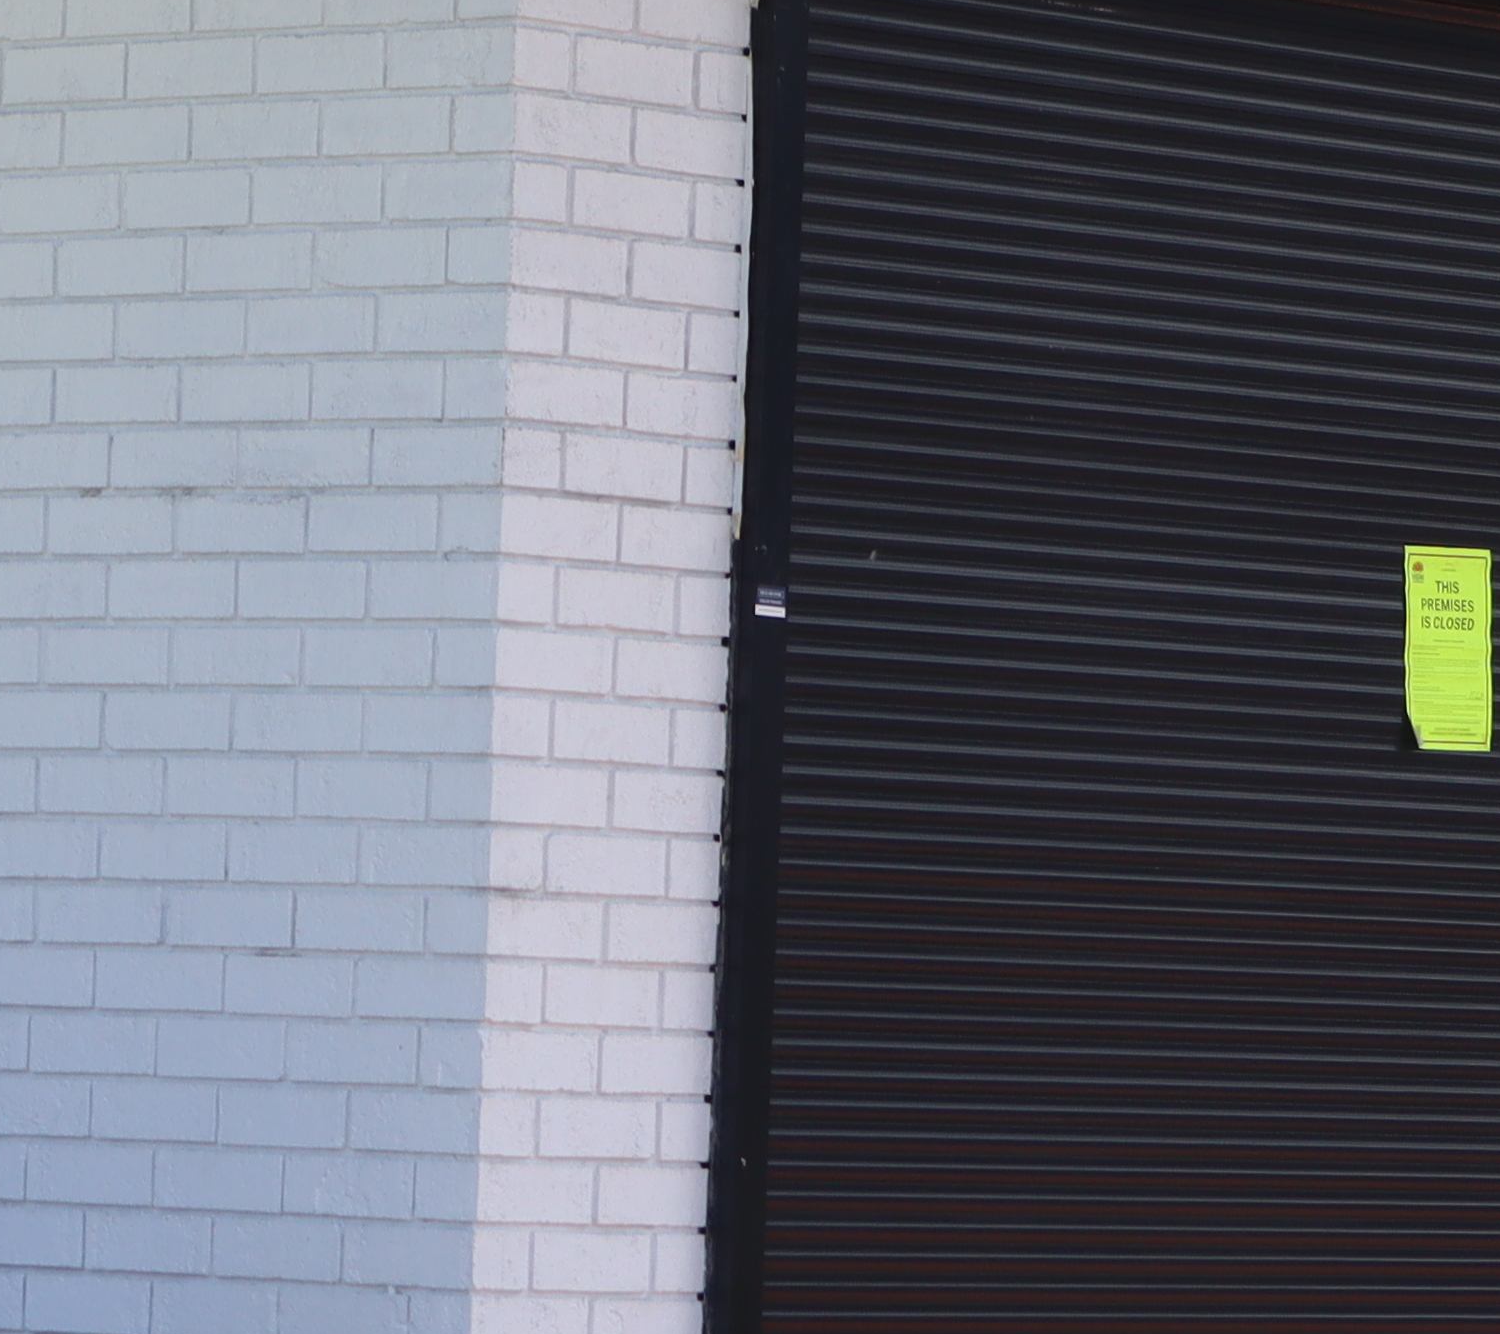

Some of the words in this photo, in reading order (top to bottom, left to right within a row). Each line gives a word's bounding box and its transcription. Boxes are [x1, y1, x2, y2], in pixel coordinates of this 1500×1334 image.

[1434, 580, 1460, 594] THIS
[1420, 598, 1475, 613] PREMISES
[1421, 615, 1431, 629] IS
[1433, 616, 1475, 631] CLOSED
